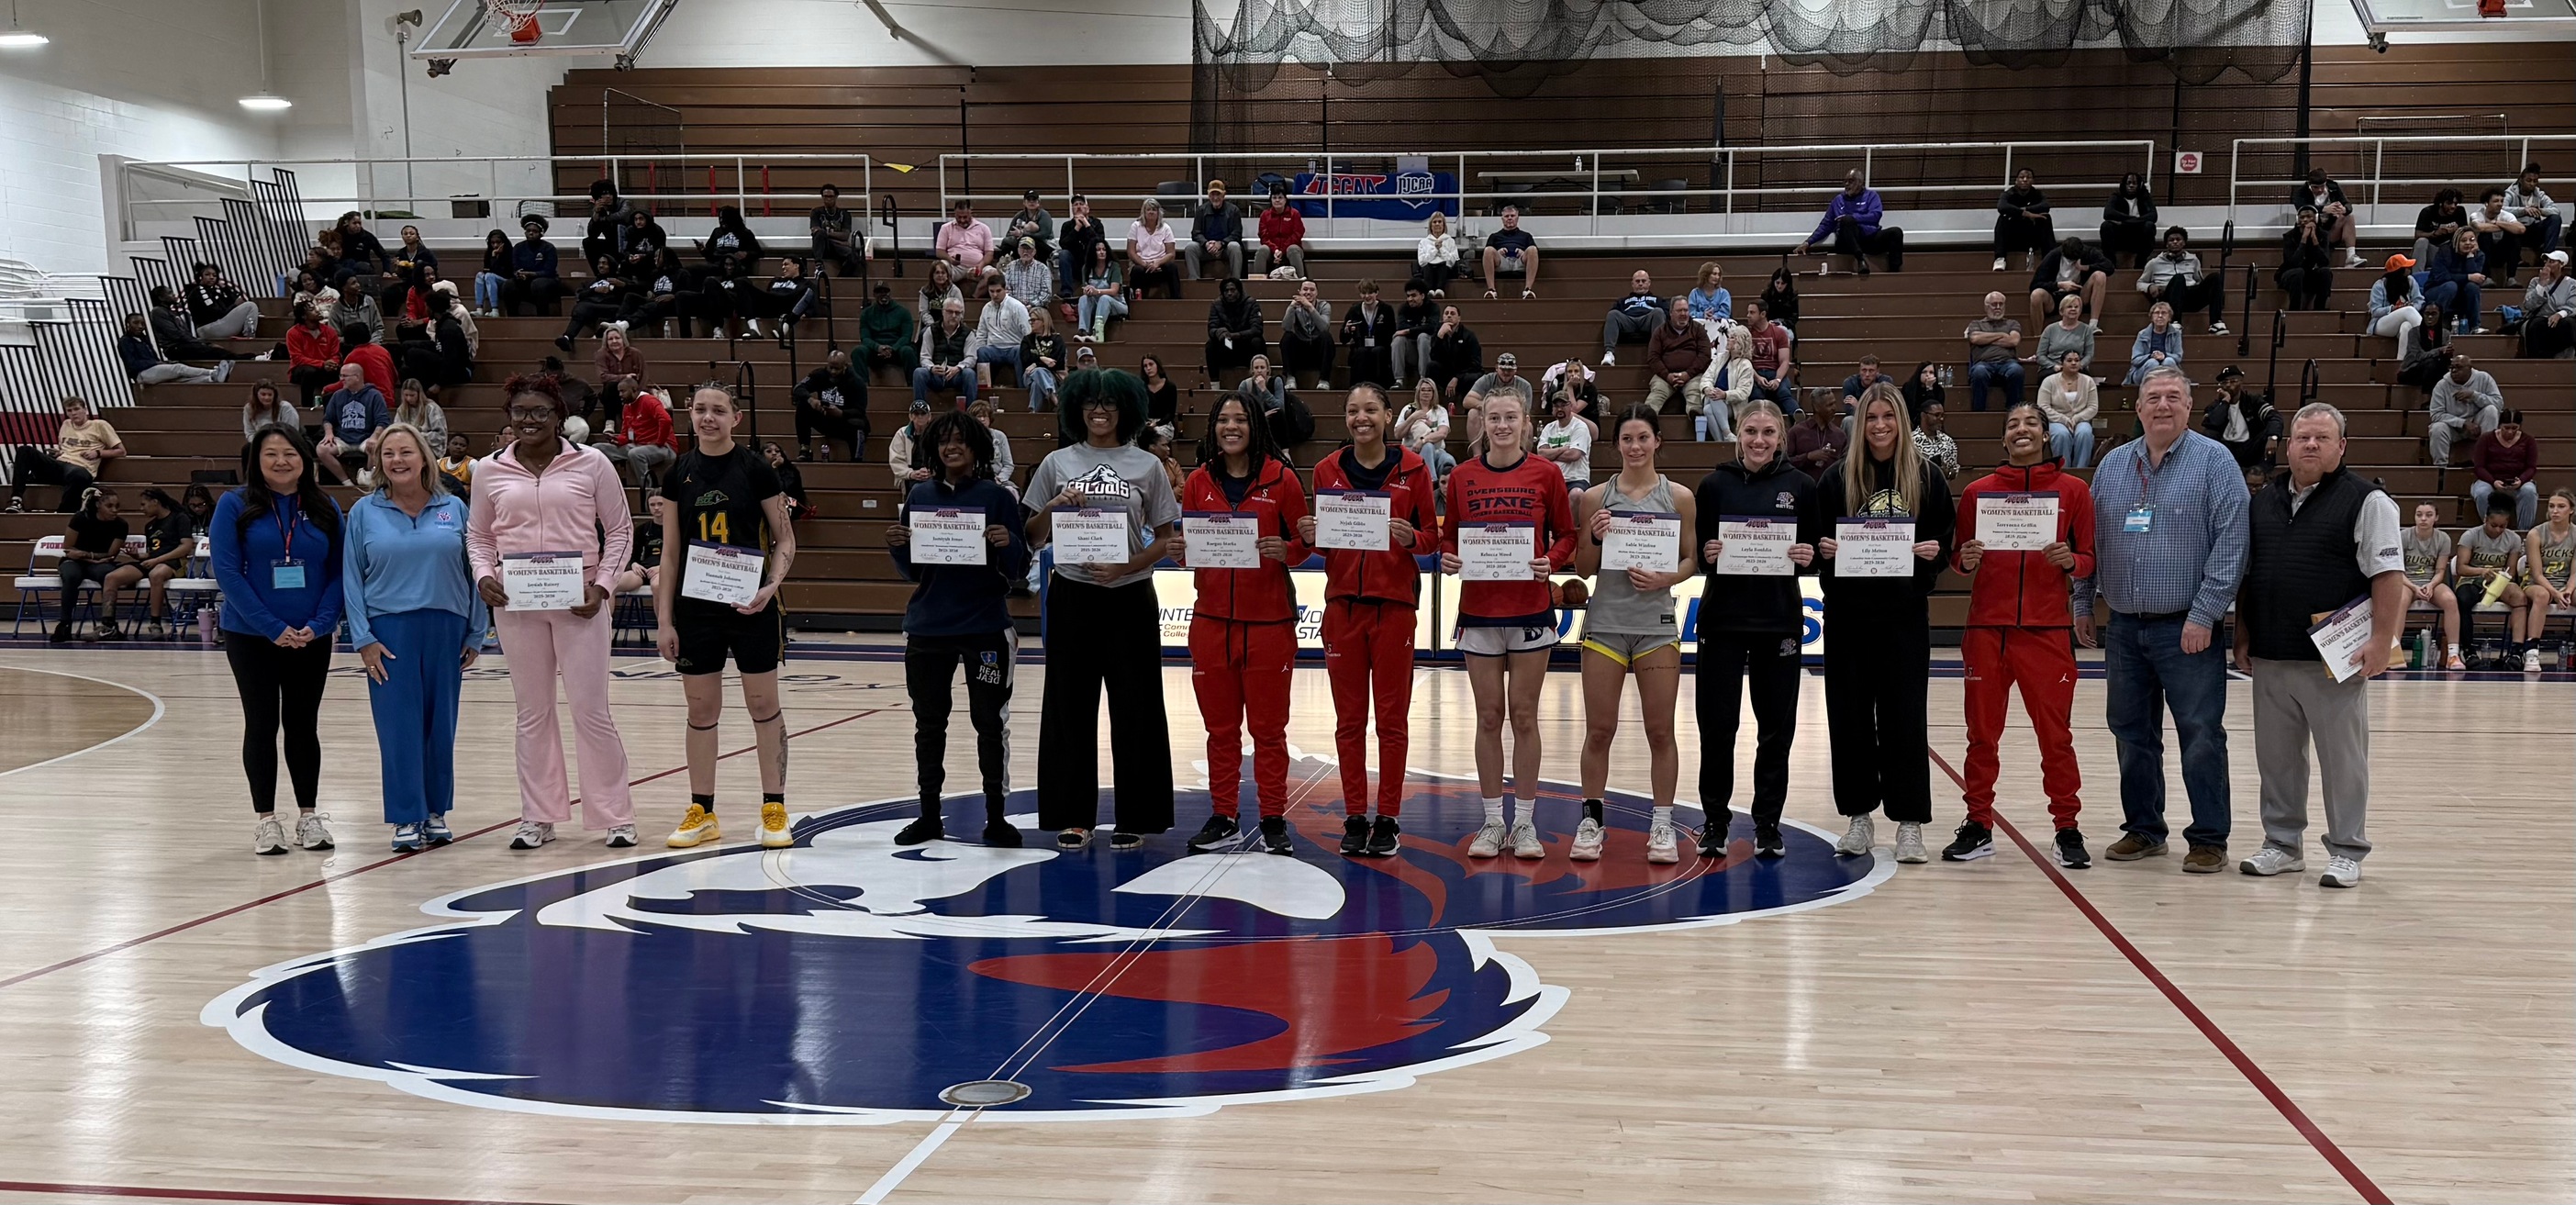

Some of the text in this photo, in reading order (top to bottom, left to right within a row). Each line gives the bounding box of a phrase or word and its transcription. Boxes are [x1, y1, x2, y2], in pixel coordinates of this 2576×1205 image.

[1316, 174, 1381, 201] TCCAA
[1397, 175, 1433, 195] NJCAA
[1467, 487, 1536, 497] DYERSBURG
[1467, 497, 1537, 513] STATE
[697, 510, 730, 544] 14
[2540, 549, 2574, 558] BUCKS
[721, 562, 758, 573] BASKETBALL
[2345, 611, 2374, 633] BASKETBAL
[979, 664, 1002, 677] REAL
[976, 672, 1000, 685] DEAL
